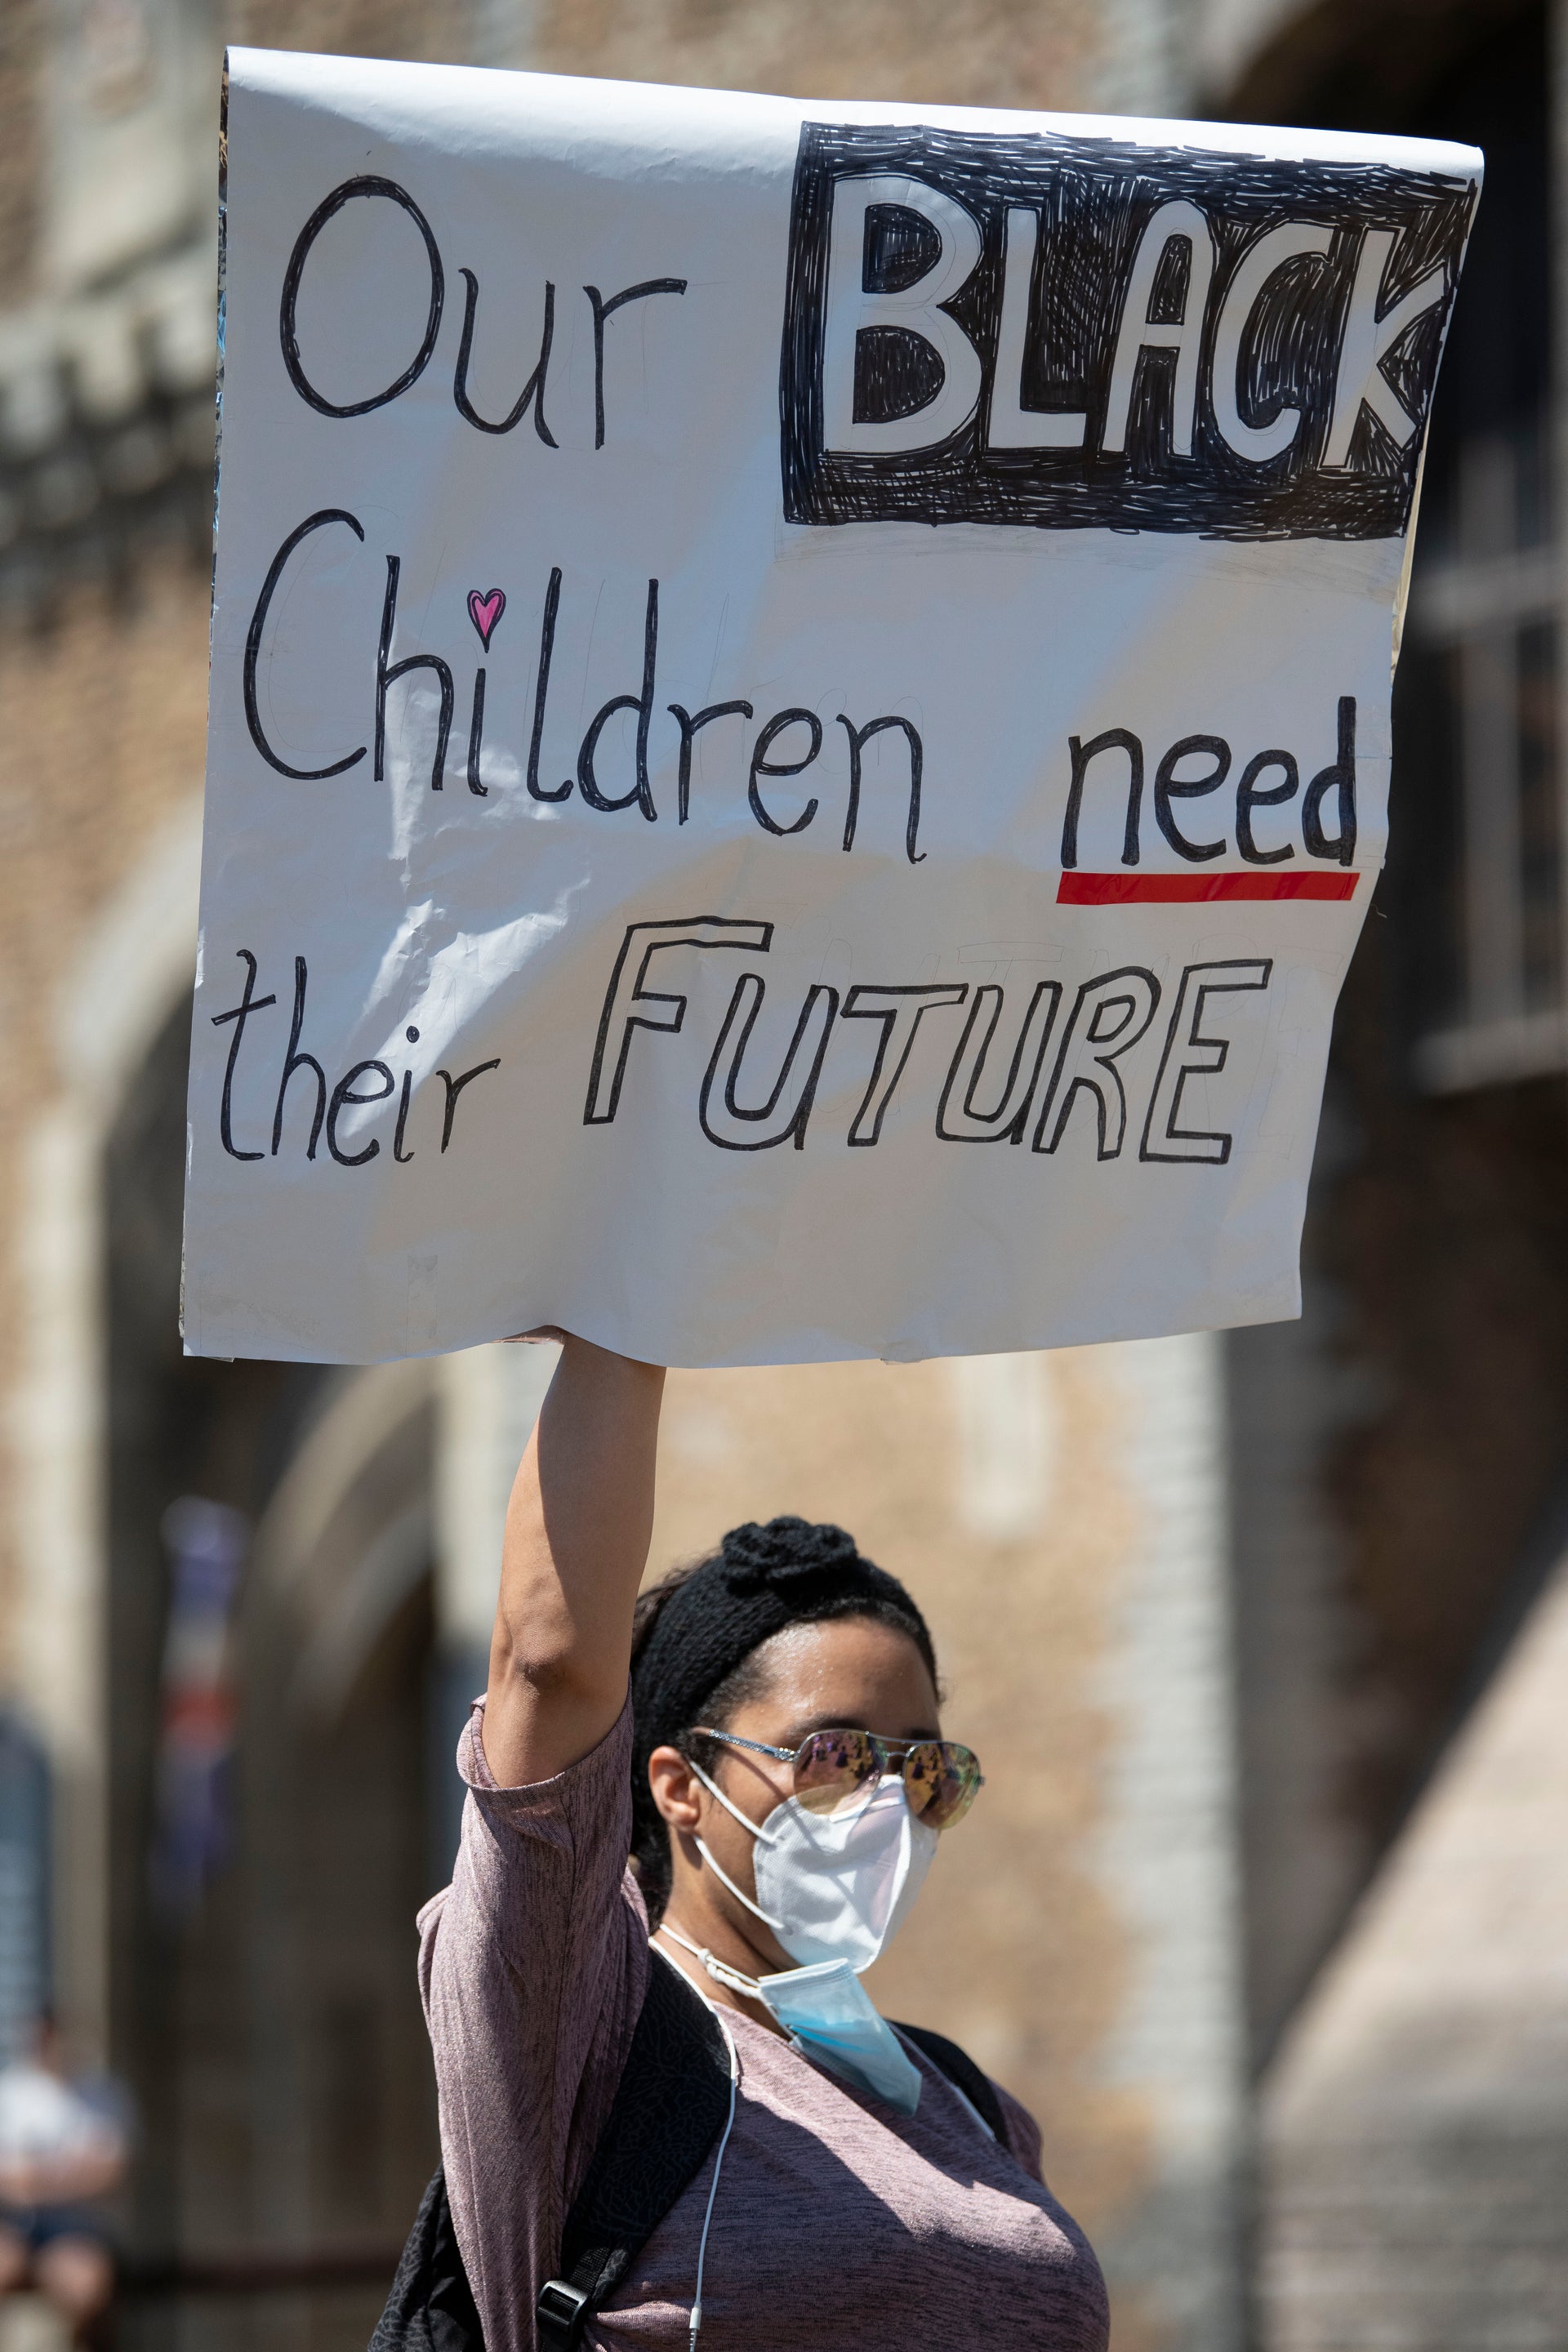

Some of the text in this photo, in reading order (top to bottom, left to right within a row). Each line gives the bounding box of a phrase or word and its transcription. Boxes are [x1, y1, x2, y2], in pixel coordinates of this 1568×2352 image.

[280, 174, 1450, 468] Our BLACK
[243, 509, 1357, 868] Children need
[212, 915, 1273, 1166] their FUTURE
